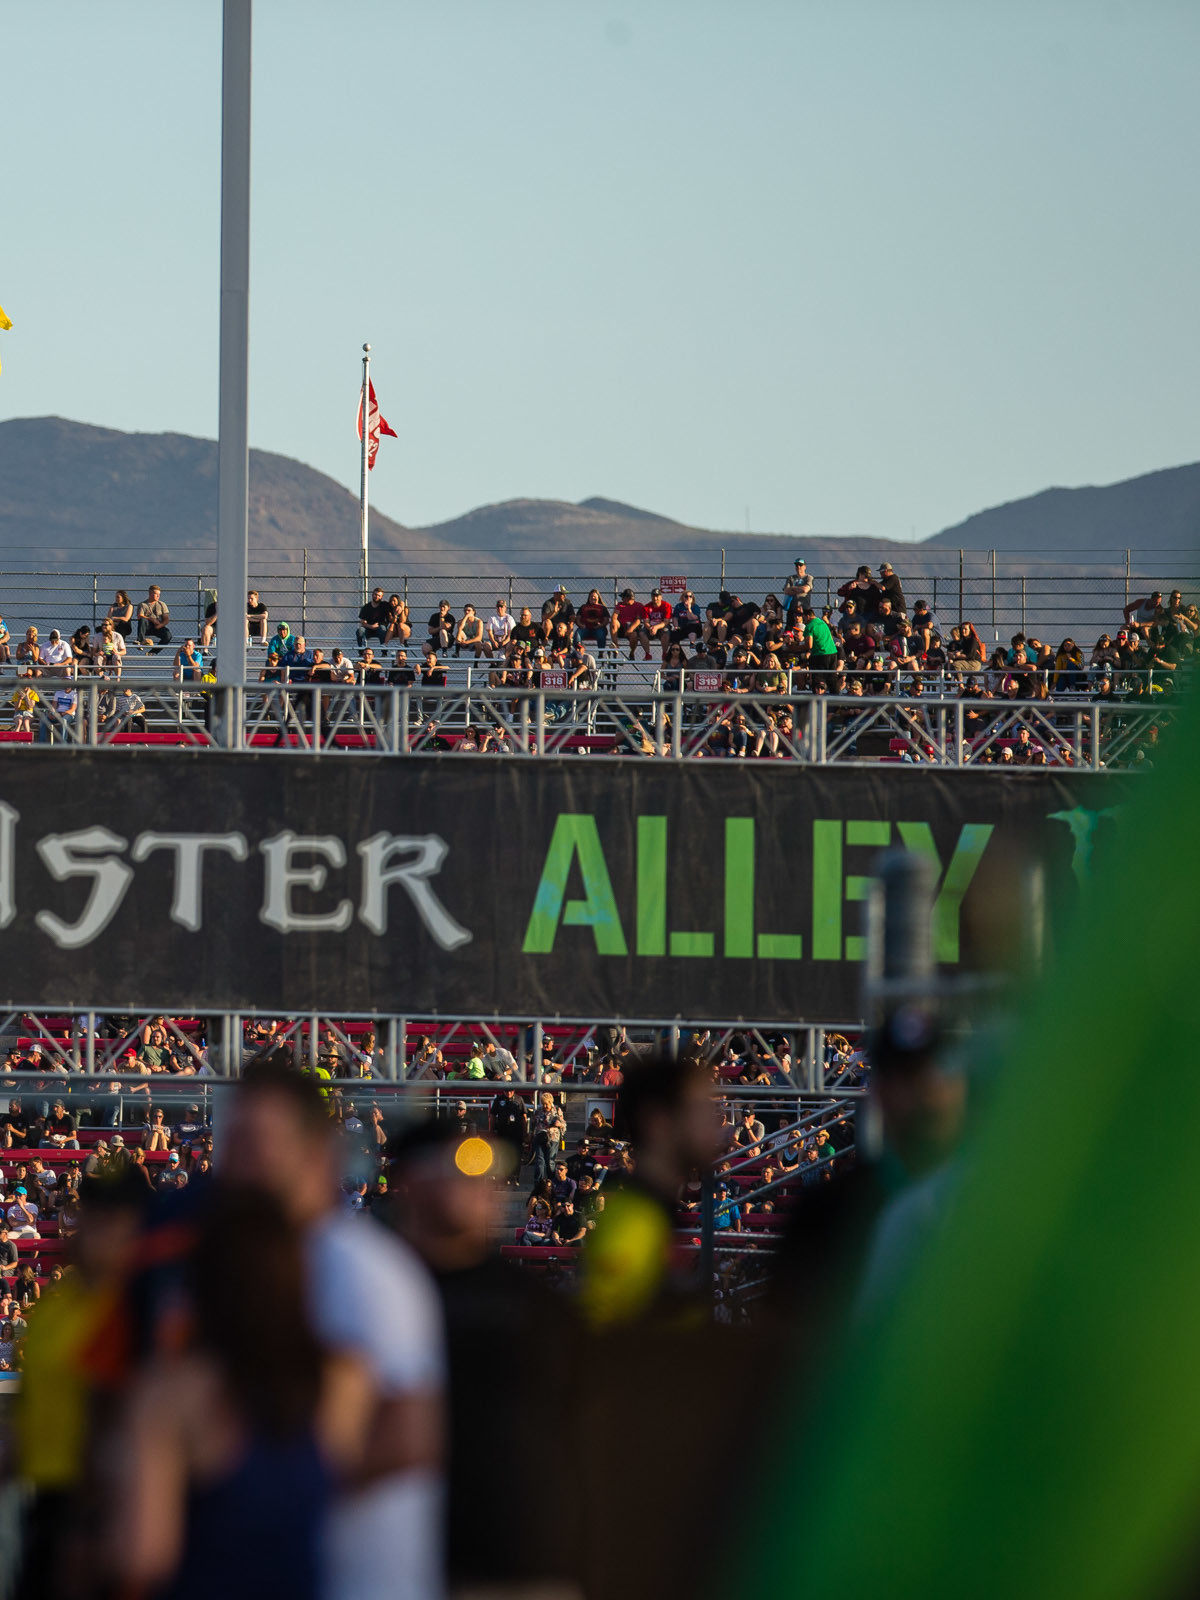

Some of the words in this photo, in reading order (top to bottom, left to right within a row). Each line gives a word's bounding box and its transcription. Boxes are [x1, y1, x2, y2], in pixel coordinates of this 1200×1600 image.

[545, 677, 563, 685] 318
[699, 678, 718, 686] 319
[522, 813, 995, 963] ALLEY
